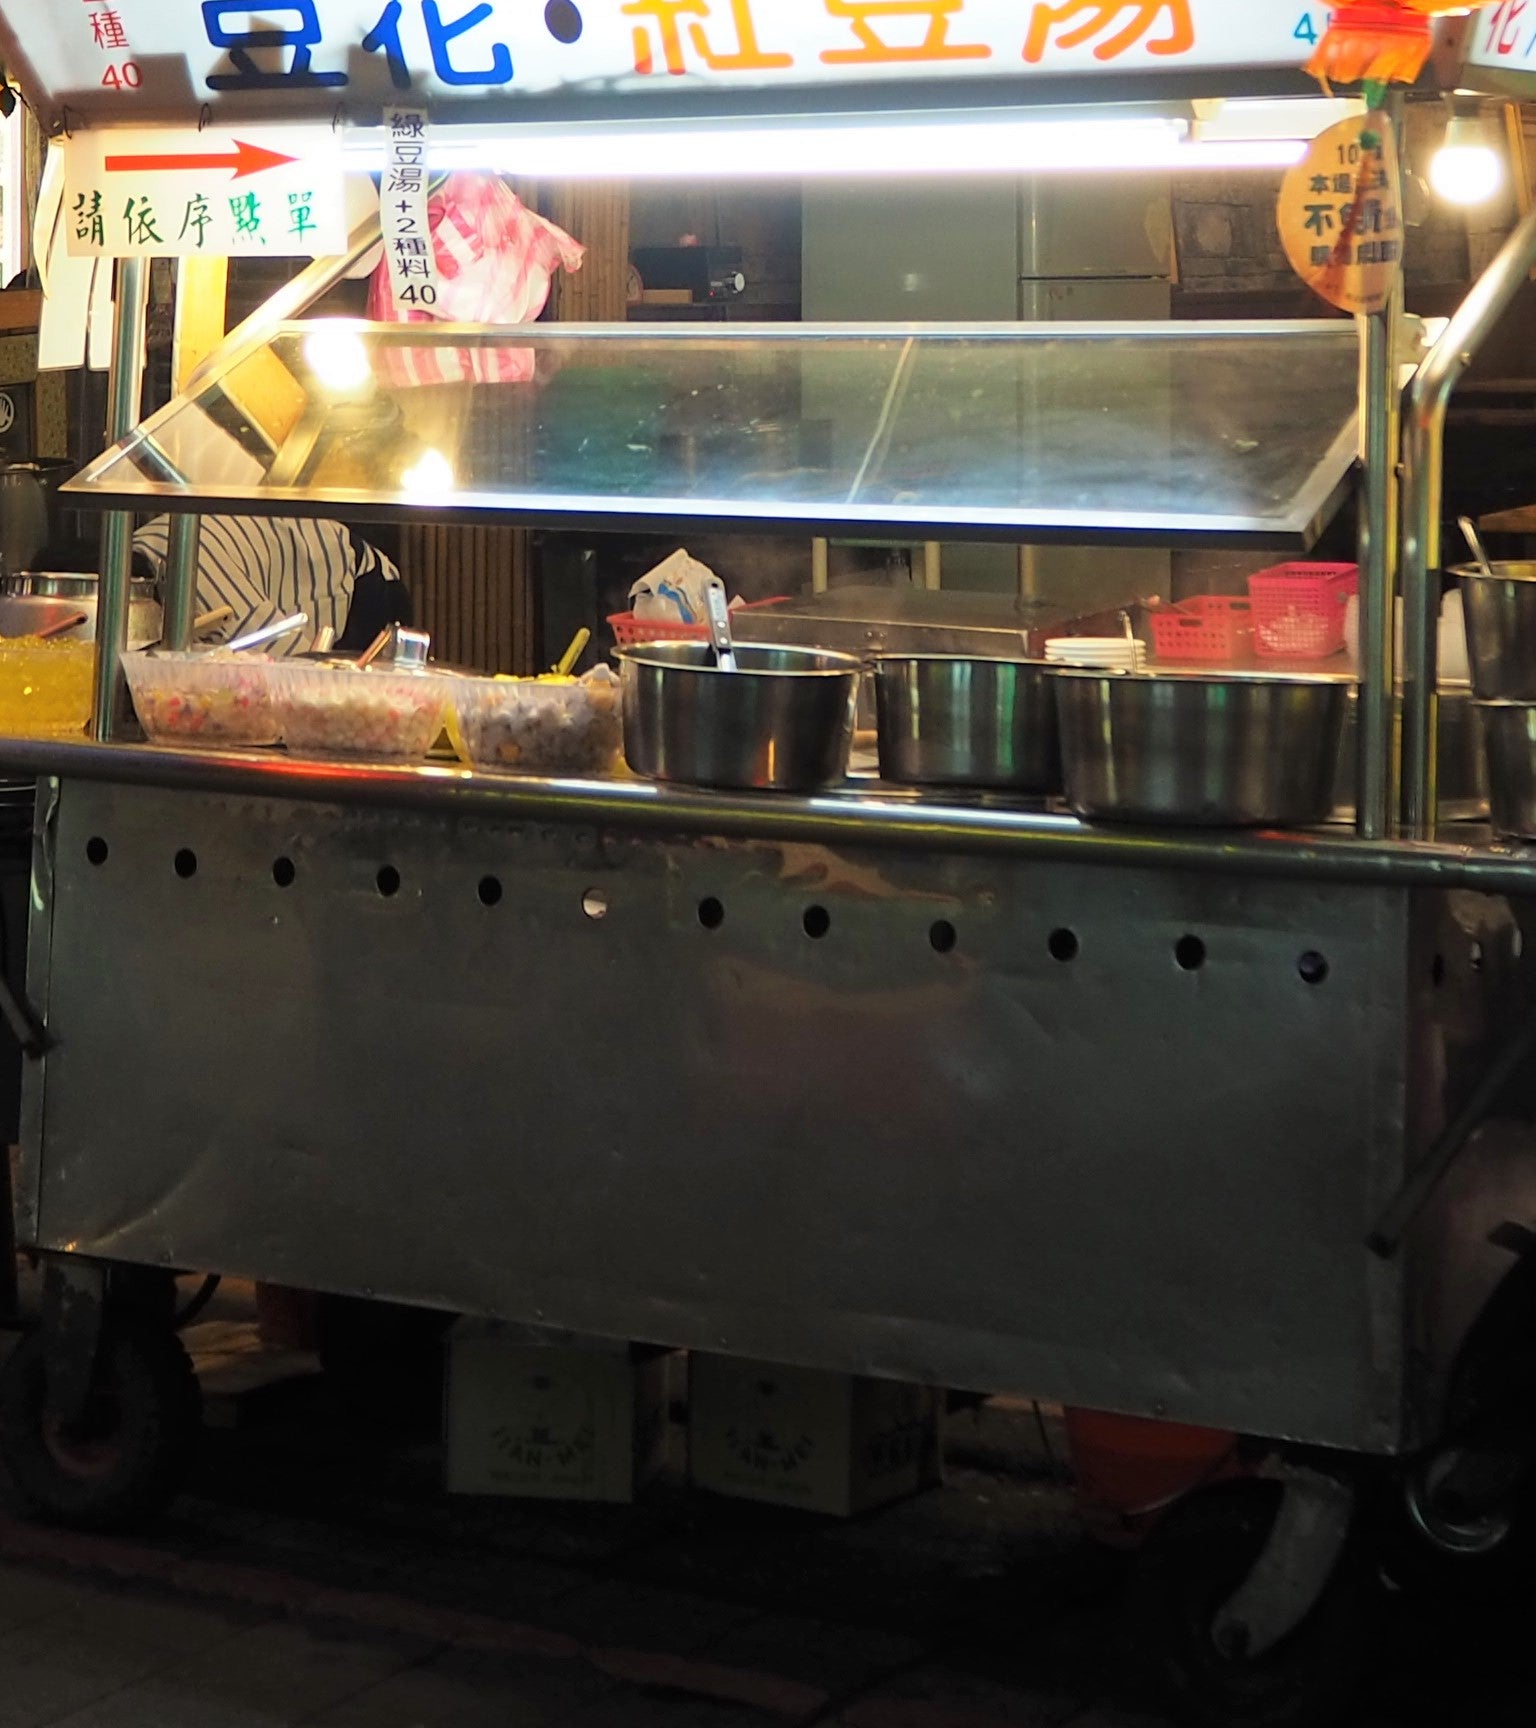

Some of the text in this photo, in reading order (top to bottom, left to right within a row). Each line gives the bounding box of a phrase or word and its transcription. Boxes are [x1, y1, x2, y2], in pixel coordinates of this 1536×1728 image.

[70, 190, 319, 250] 請依序點單
